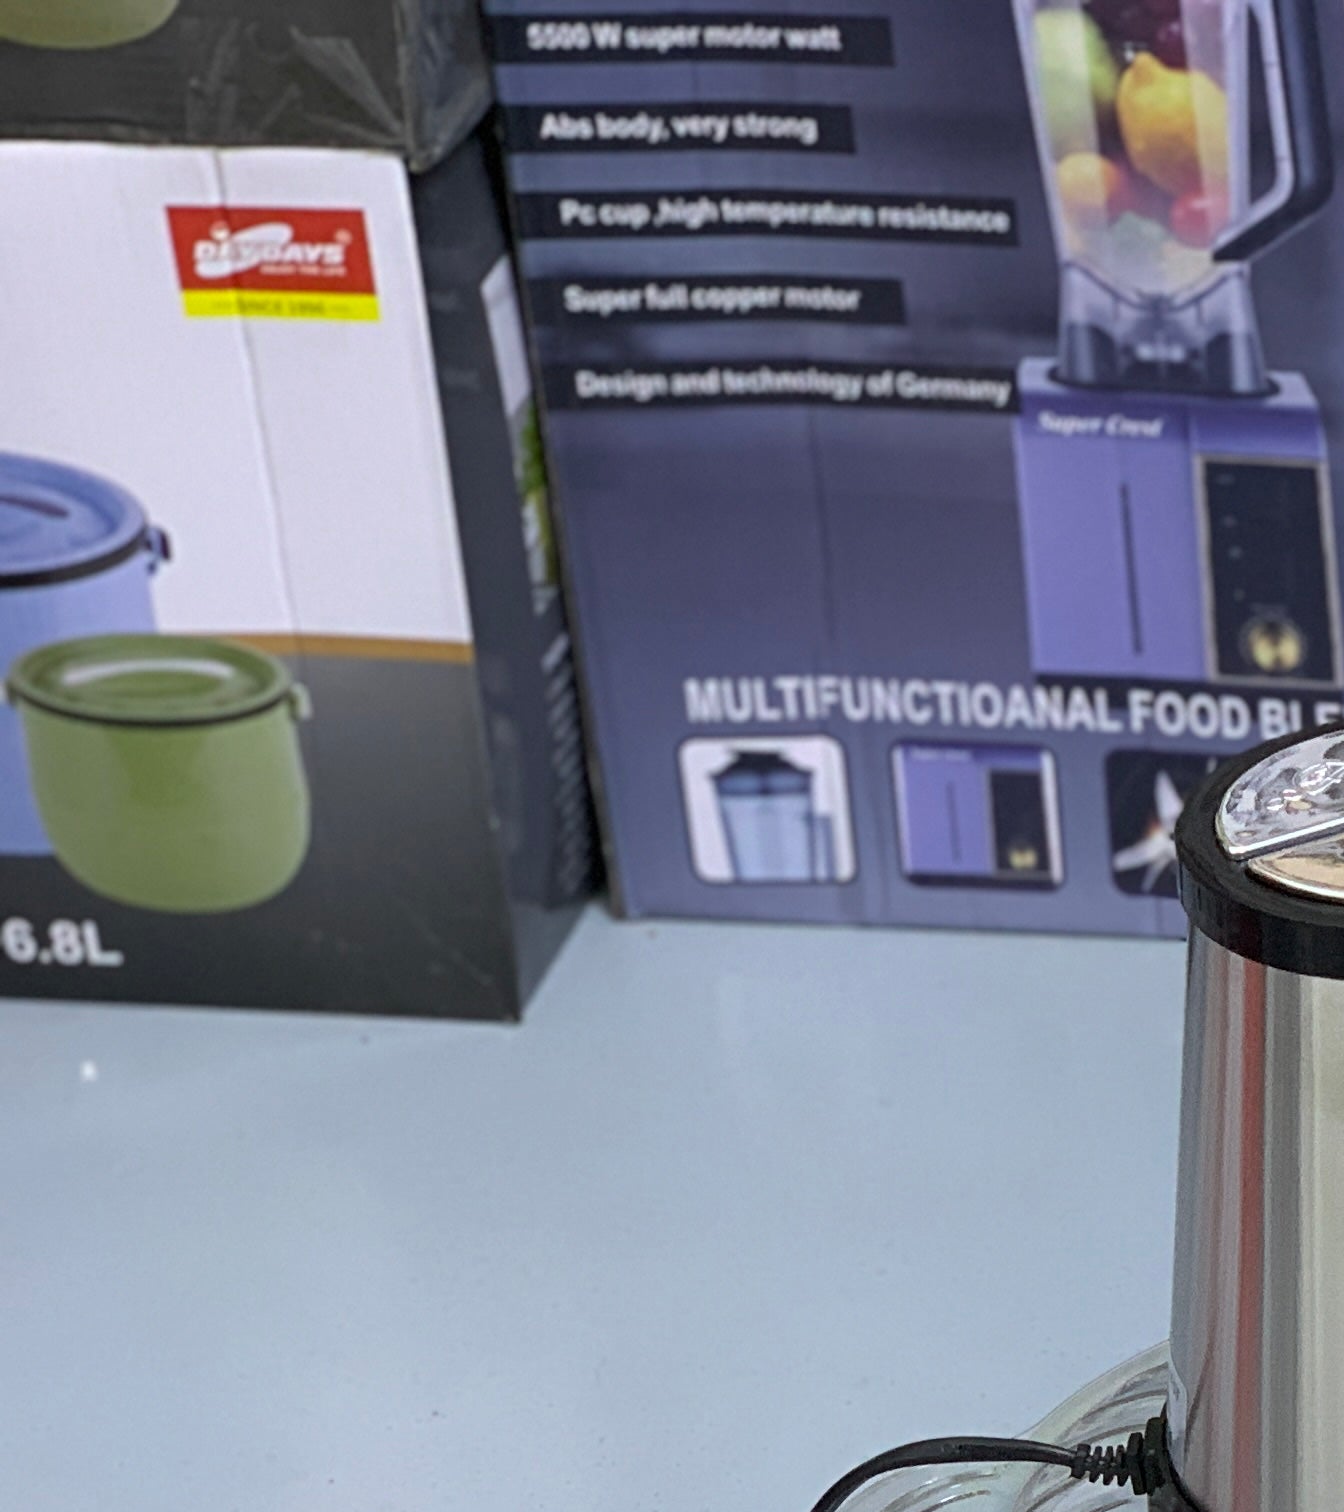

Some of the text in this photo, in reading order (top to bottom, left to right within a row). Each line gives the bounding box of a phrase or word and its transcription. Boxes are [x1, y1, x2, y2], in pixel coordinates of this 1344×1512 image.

[527, 24, 841, 51] 5500 W super motor watt
[541, 115, 818, 143] Abs body, very strong
[560, 201, 595, 224] Pc
[601, 206, 649, 228] cup
[720, 201, 874, 231] temperature
[877, 206, 1009, 231] resistance
[565, 286, 860, 313] Super full copper motor
[576, 369, 1009, 403] Design and technology of Germany
[685, 676, 1119, 732] MULTIFUNCTIOANAL
[1129, 689, 1248, 738] FOOD
[2, 918, 122, 964] 6.8L
